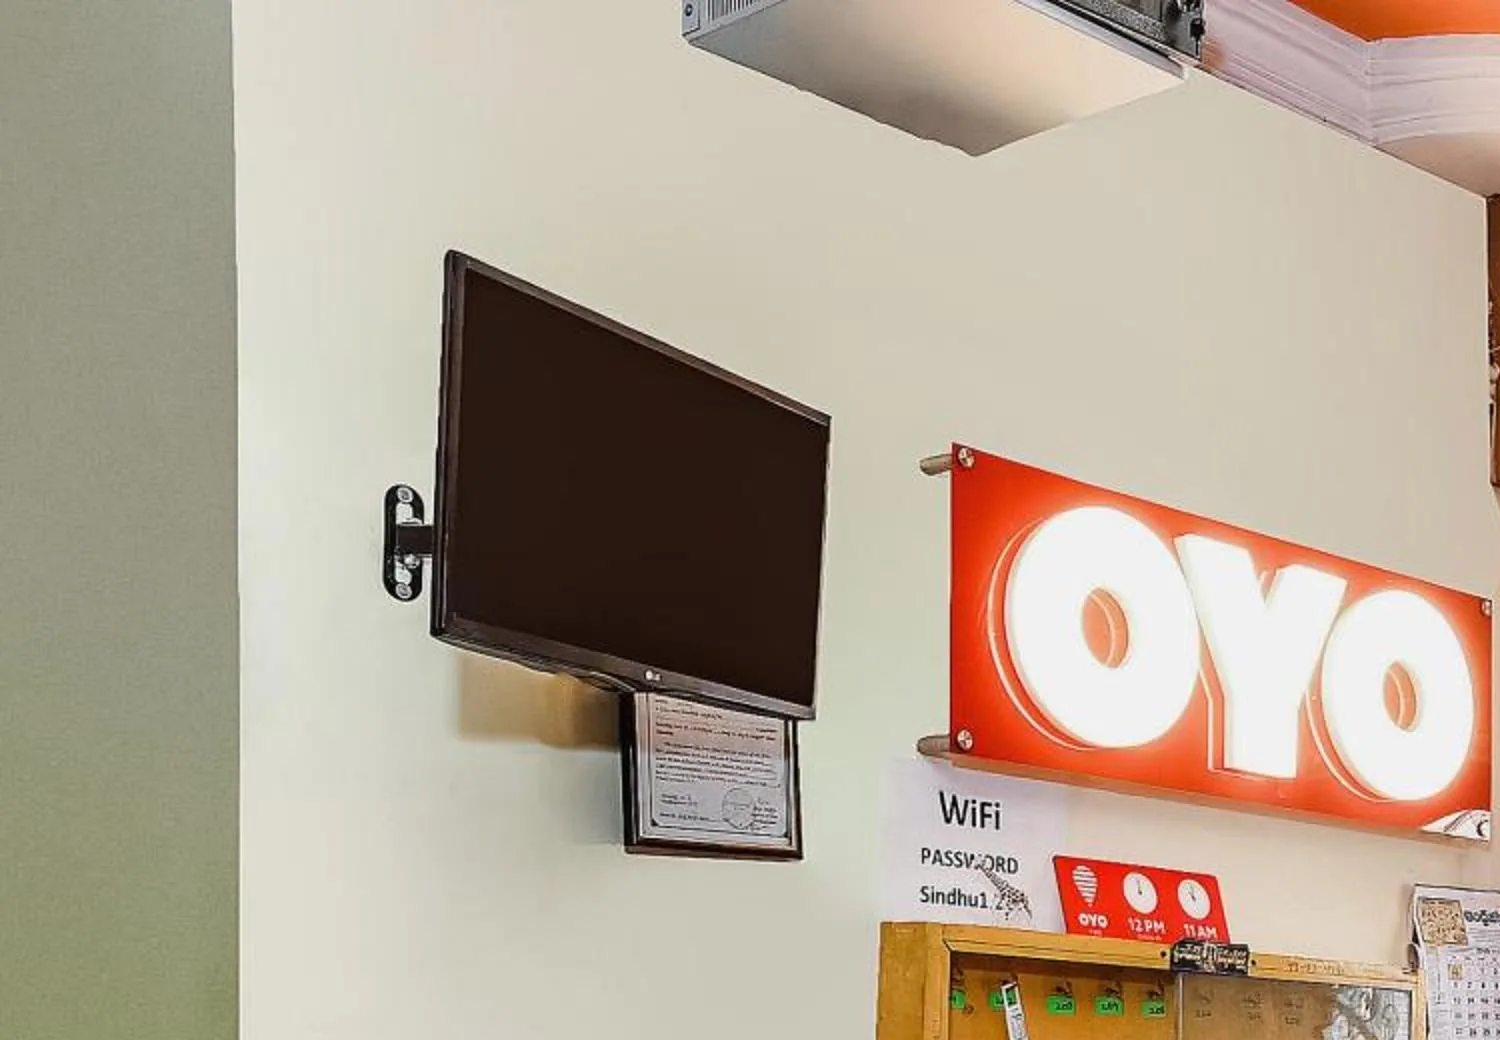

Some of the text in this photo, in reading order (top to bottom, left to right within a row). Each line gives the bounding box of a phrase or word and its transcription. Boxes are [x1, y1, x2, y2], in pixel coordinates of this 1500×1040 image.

[992, 504, 1475, 802] OYO
[939, 790, 1001, 830] WiFi
[920, 847, 1019, 875] PASSWORD
[1078, 912, 1109, 929] OYO
